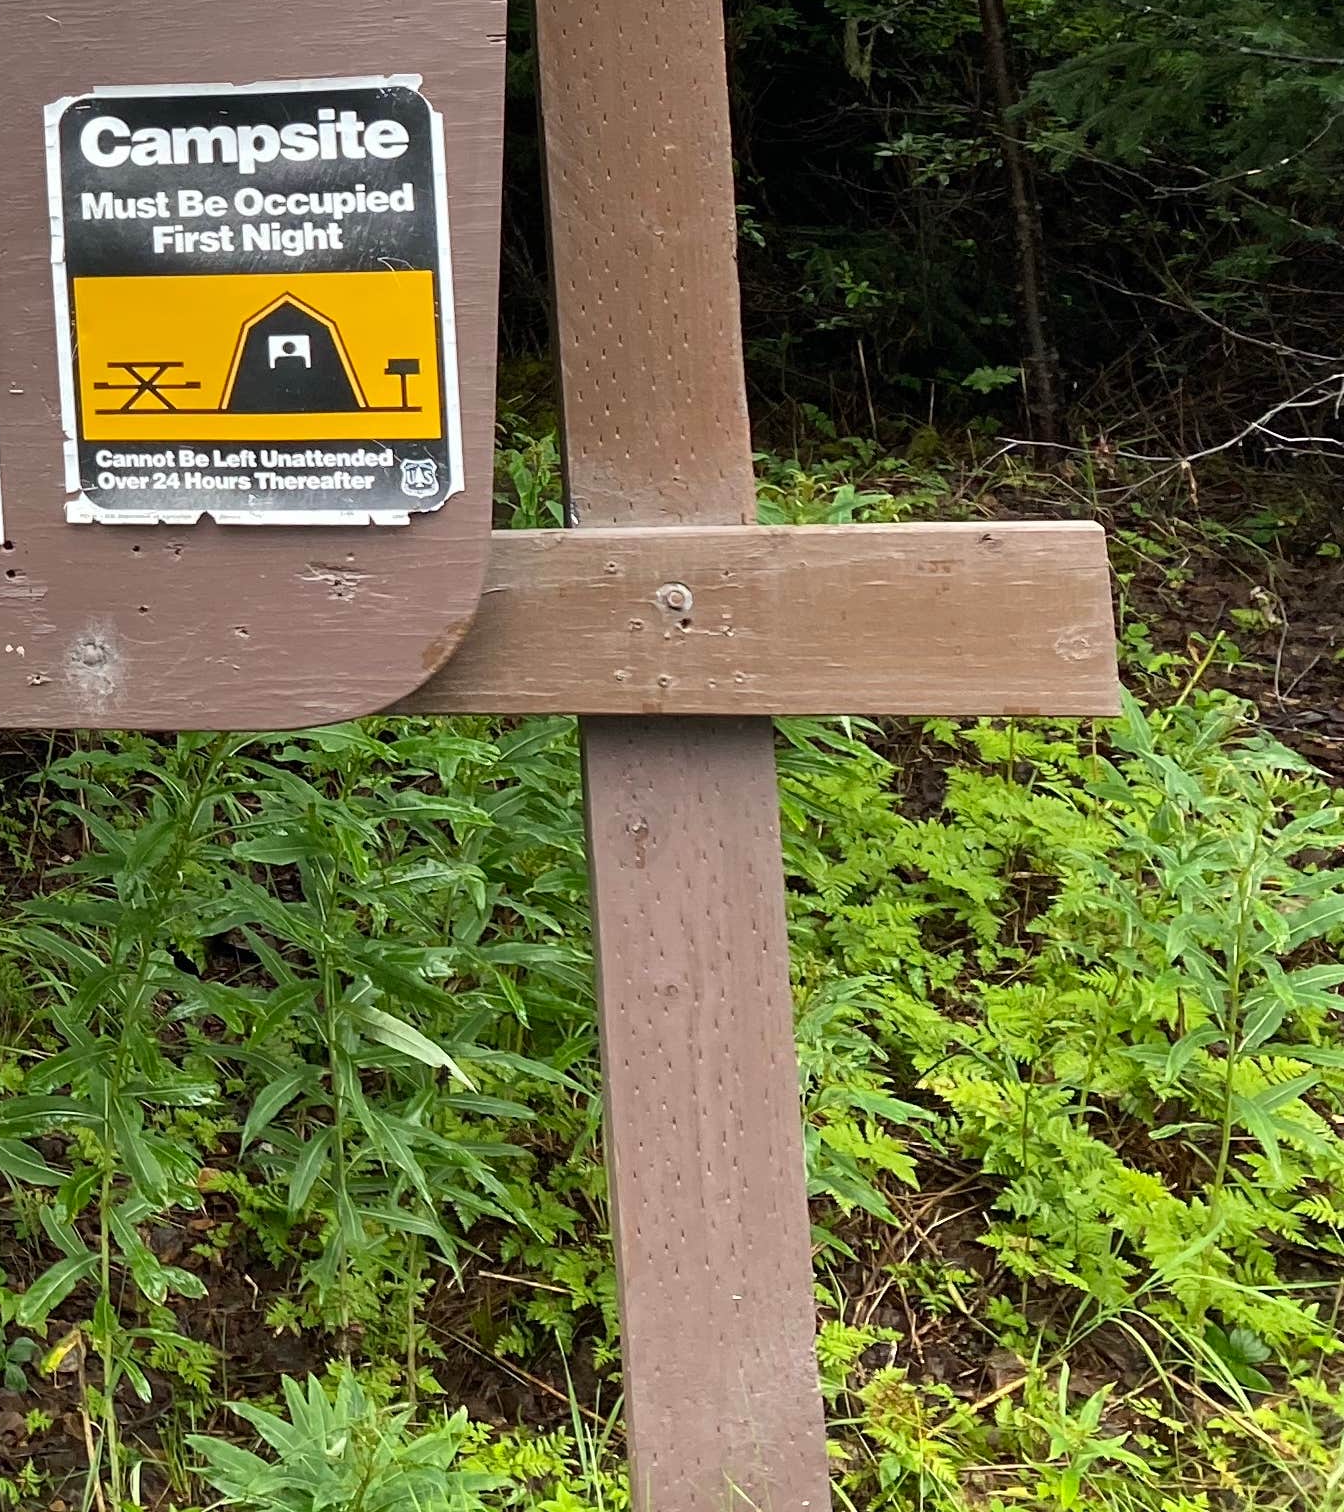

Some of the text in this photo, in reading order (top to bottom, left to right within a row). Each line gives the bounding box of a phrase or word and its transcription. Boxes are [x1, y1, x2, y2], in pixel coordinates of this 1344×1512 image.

[79, 108, 411, 175] Campsite
[81, 183, 415, 220] Must Be Occupied
[153, 222, 344, 257] First Night
[95, 448, 394, 468] Cannot Be Left Unattended
[98, 471, 375, 491] Over 24 Hours Thereafter
